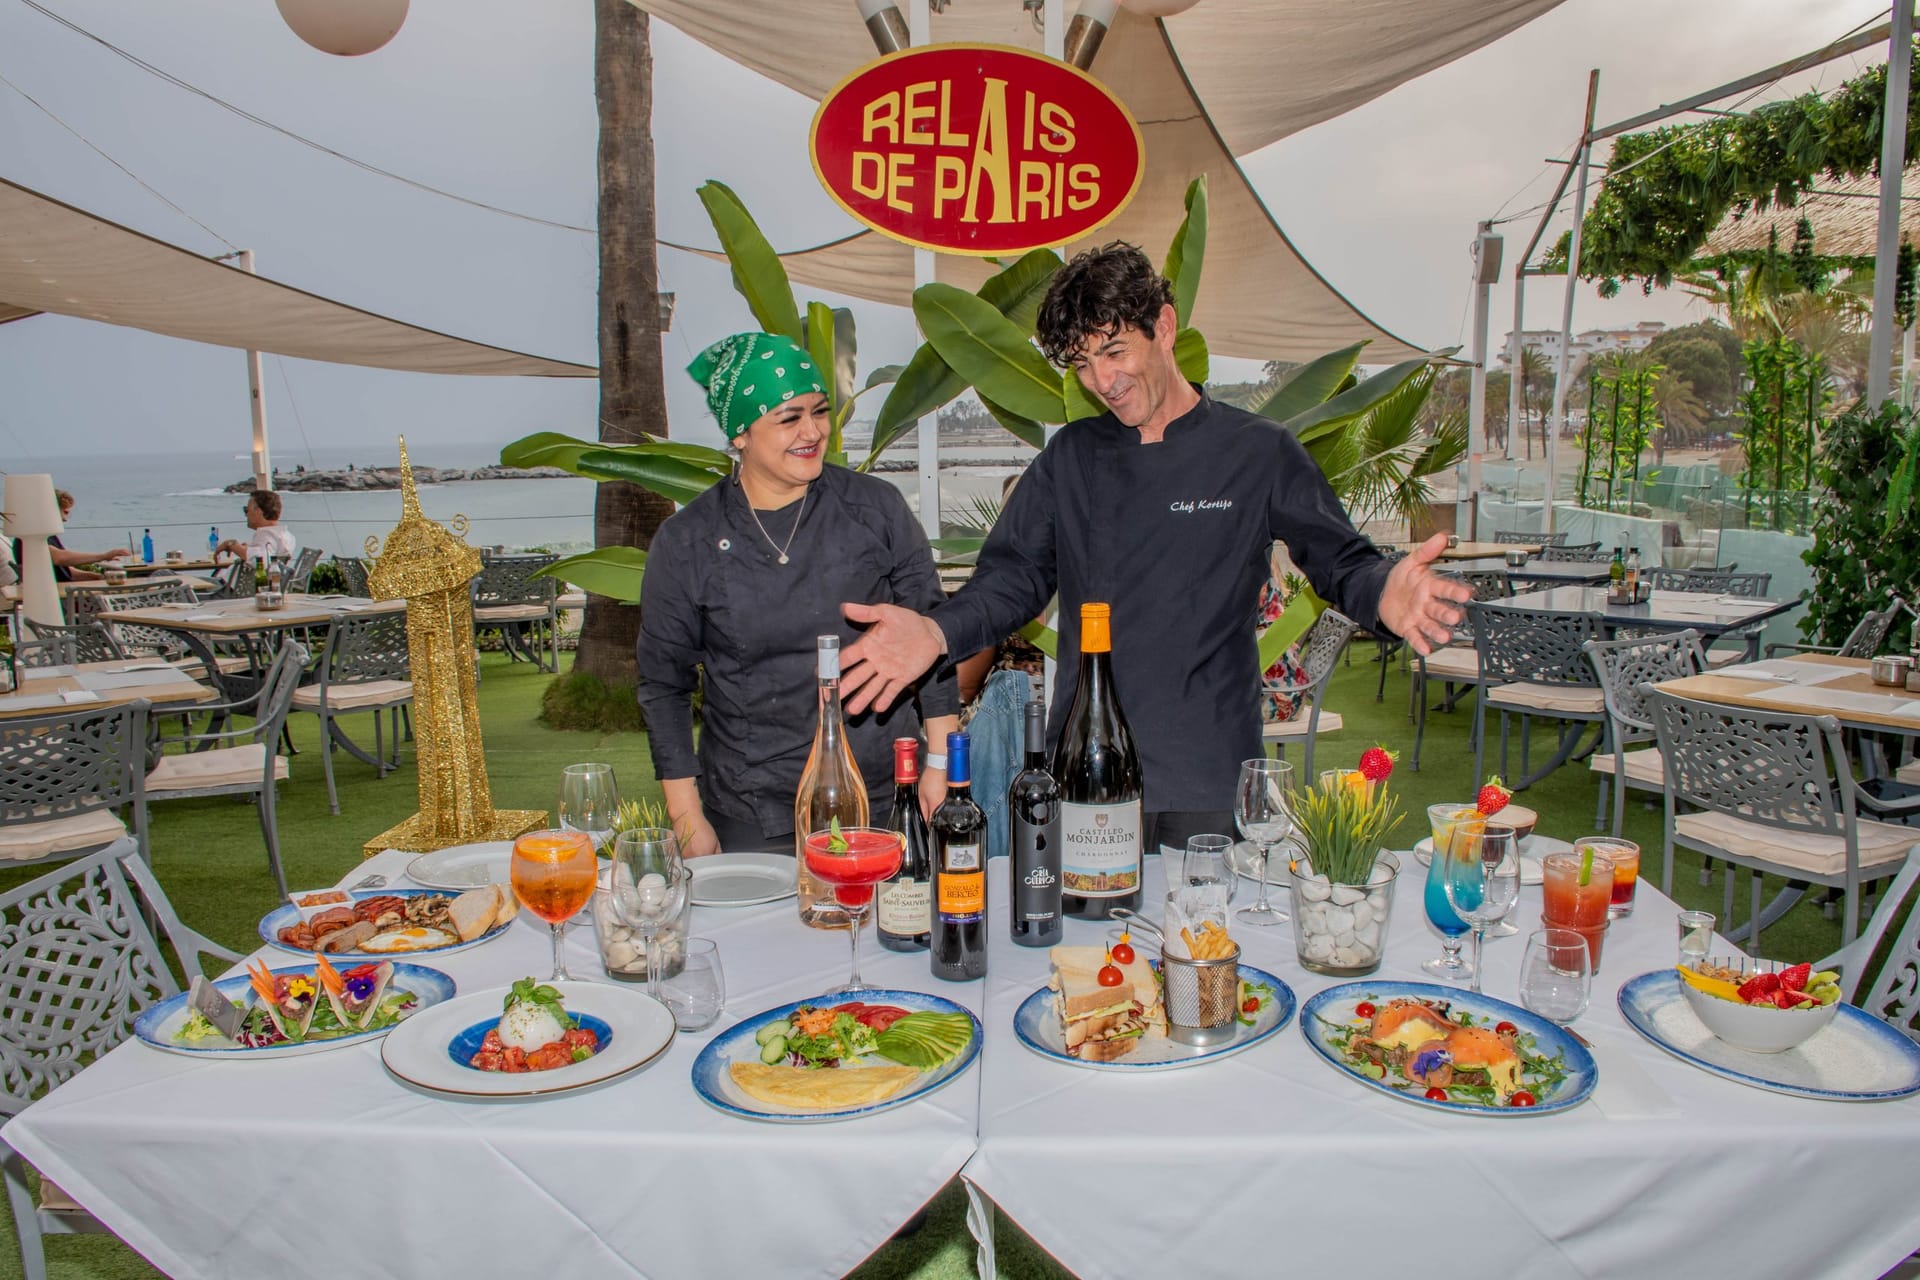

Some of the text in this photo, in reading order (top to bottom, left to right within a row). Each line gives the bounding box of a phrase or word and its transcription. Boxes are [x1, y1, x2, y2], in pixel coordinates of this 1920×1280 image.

[863, 78, 1076, 158] RELAIS
[852, 146, 1101, 223] DE PARIS
[1170, 501, 1195, 513] Chef
[1066, 832, 1135, 845] MONJARDIN
